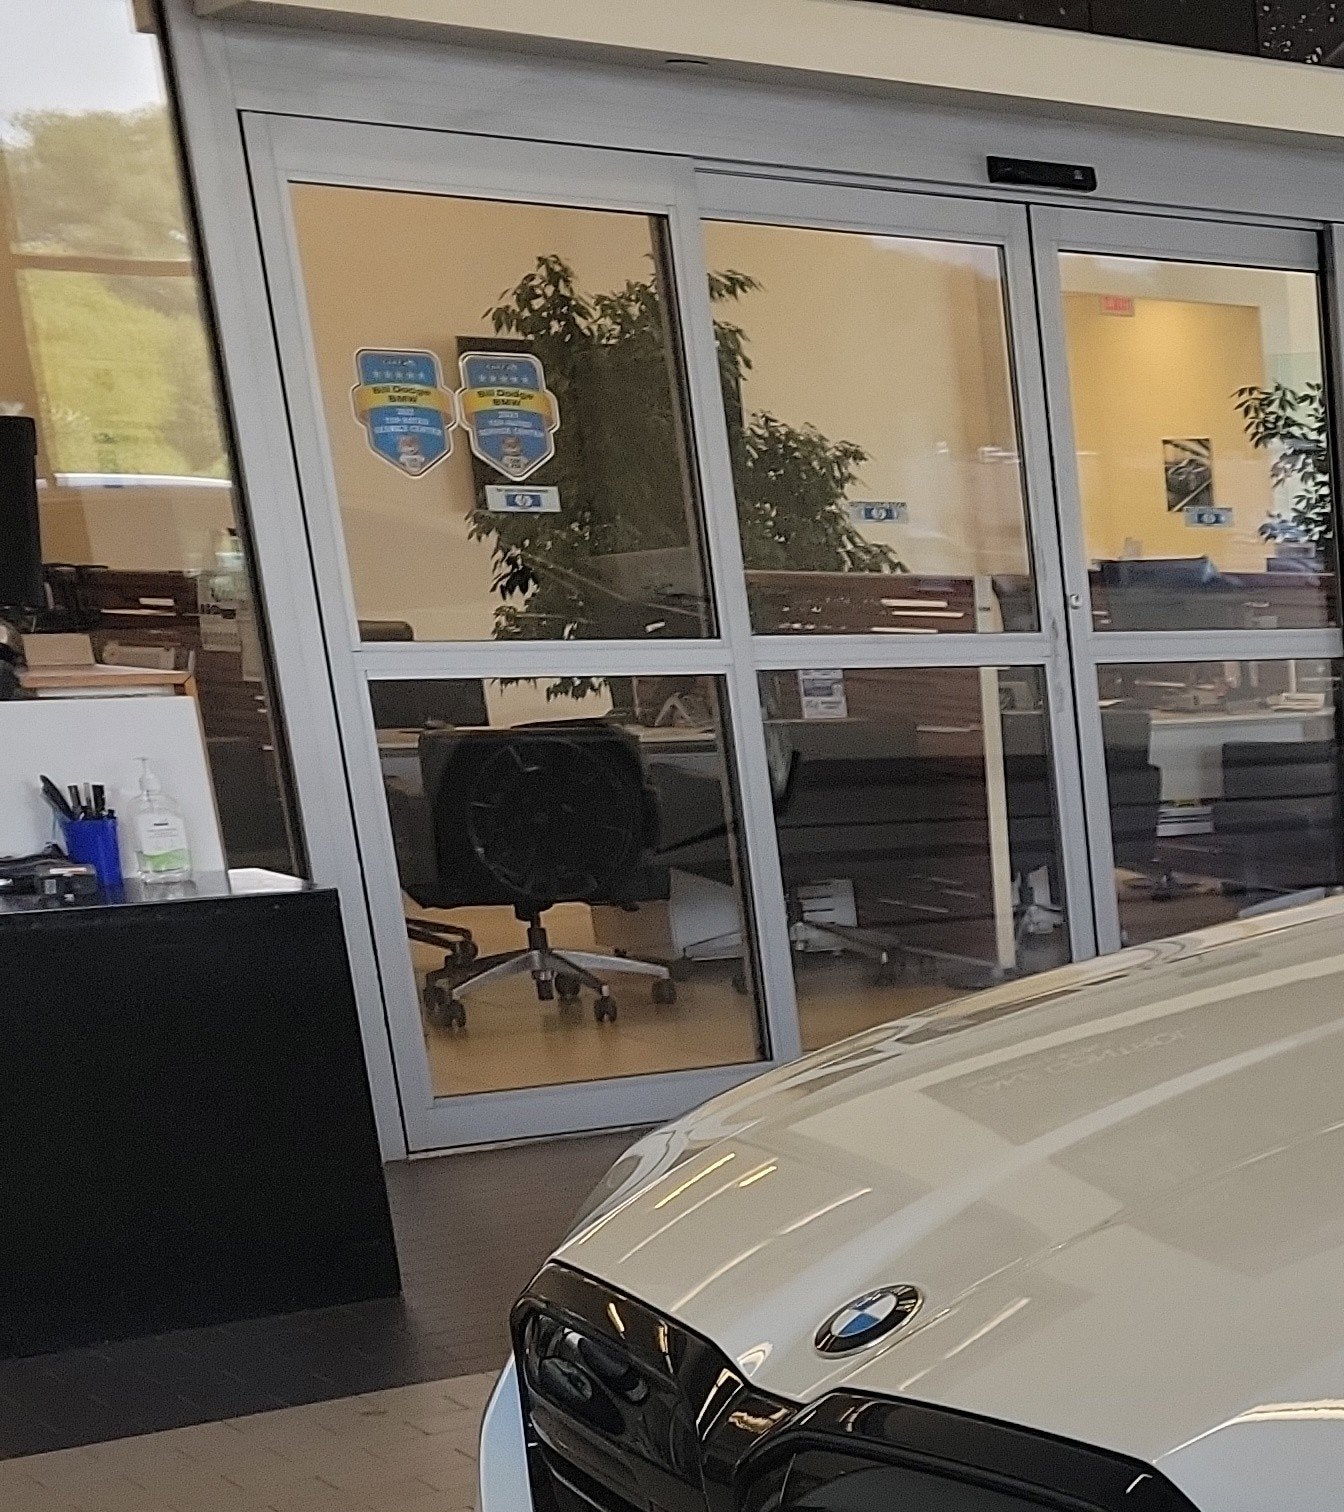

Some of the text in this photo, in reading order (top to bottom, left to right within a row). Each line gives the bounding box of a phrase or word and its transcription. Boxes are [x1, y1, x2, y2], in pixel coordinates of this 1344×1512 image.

[372, 386, 432, 396] Bill Dodge
[477, 389, 534, 400] Bill Dodge
[388, 395, 418, 403] BMW
[493, 398, 521, 406] BMW
